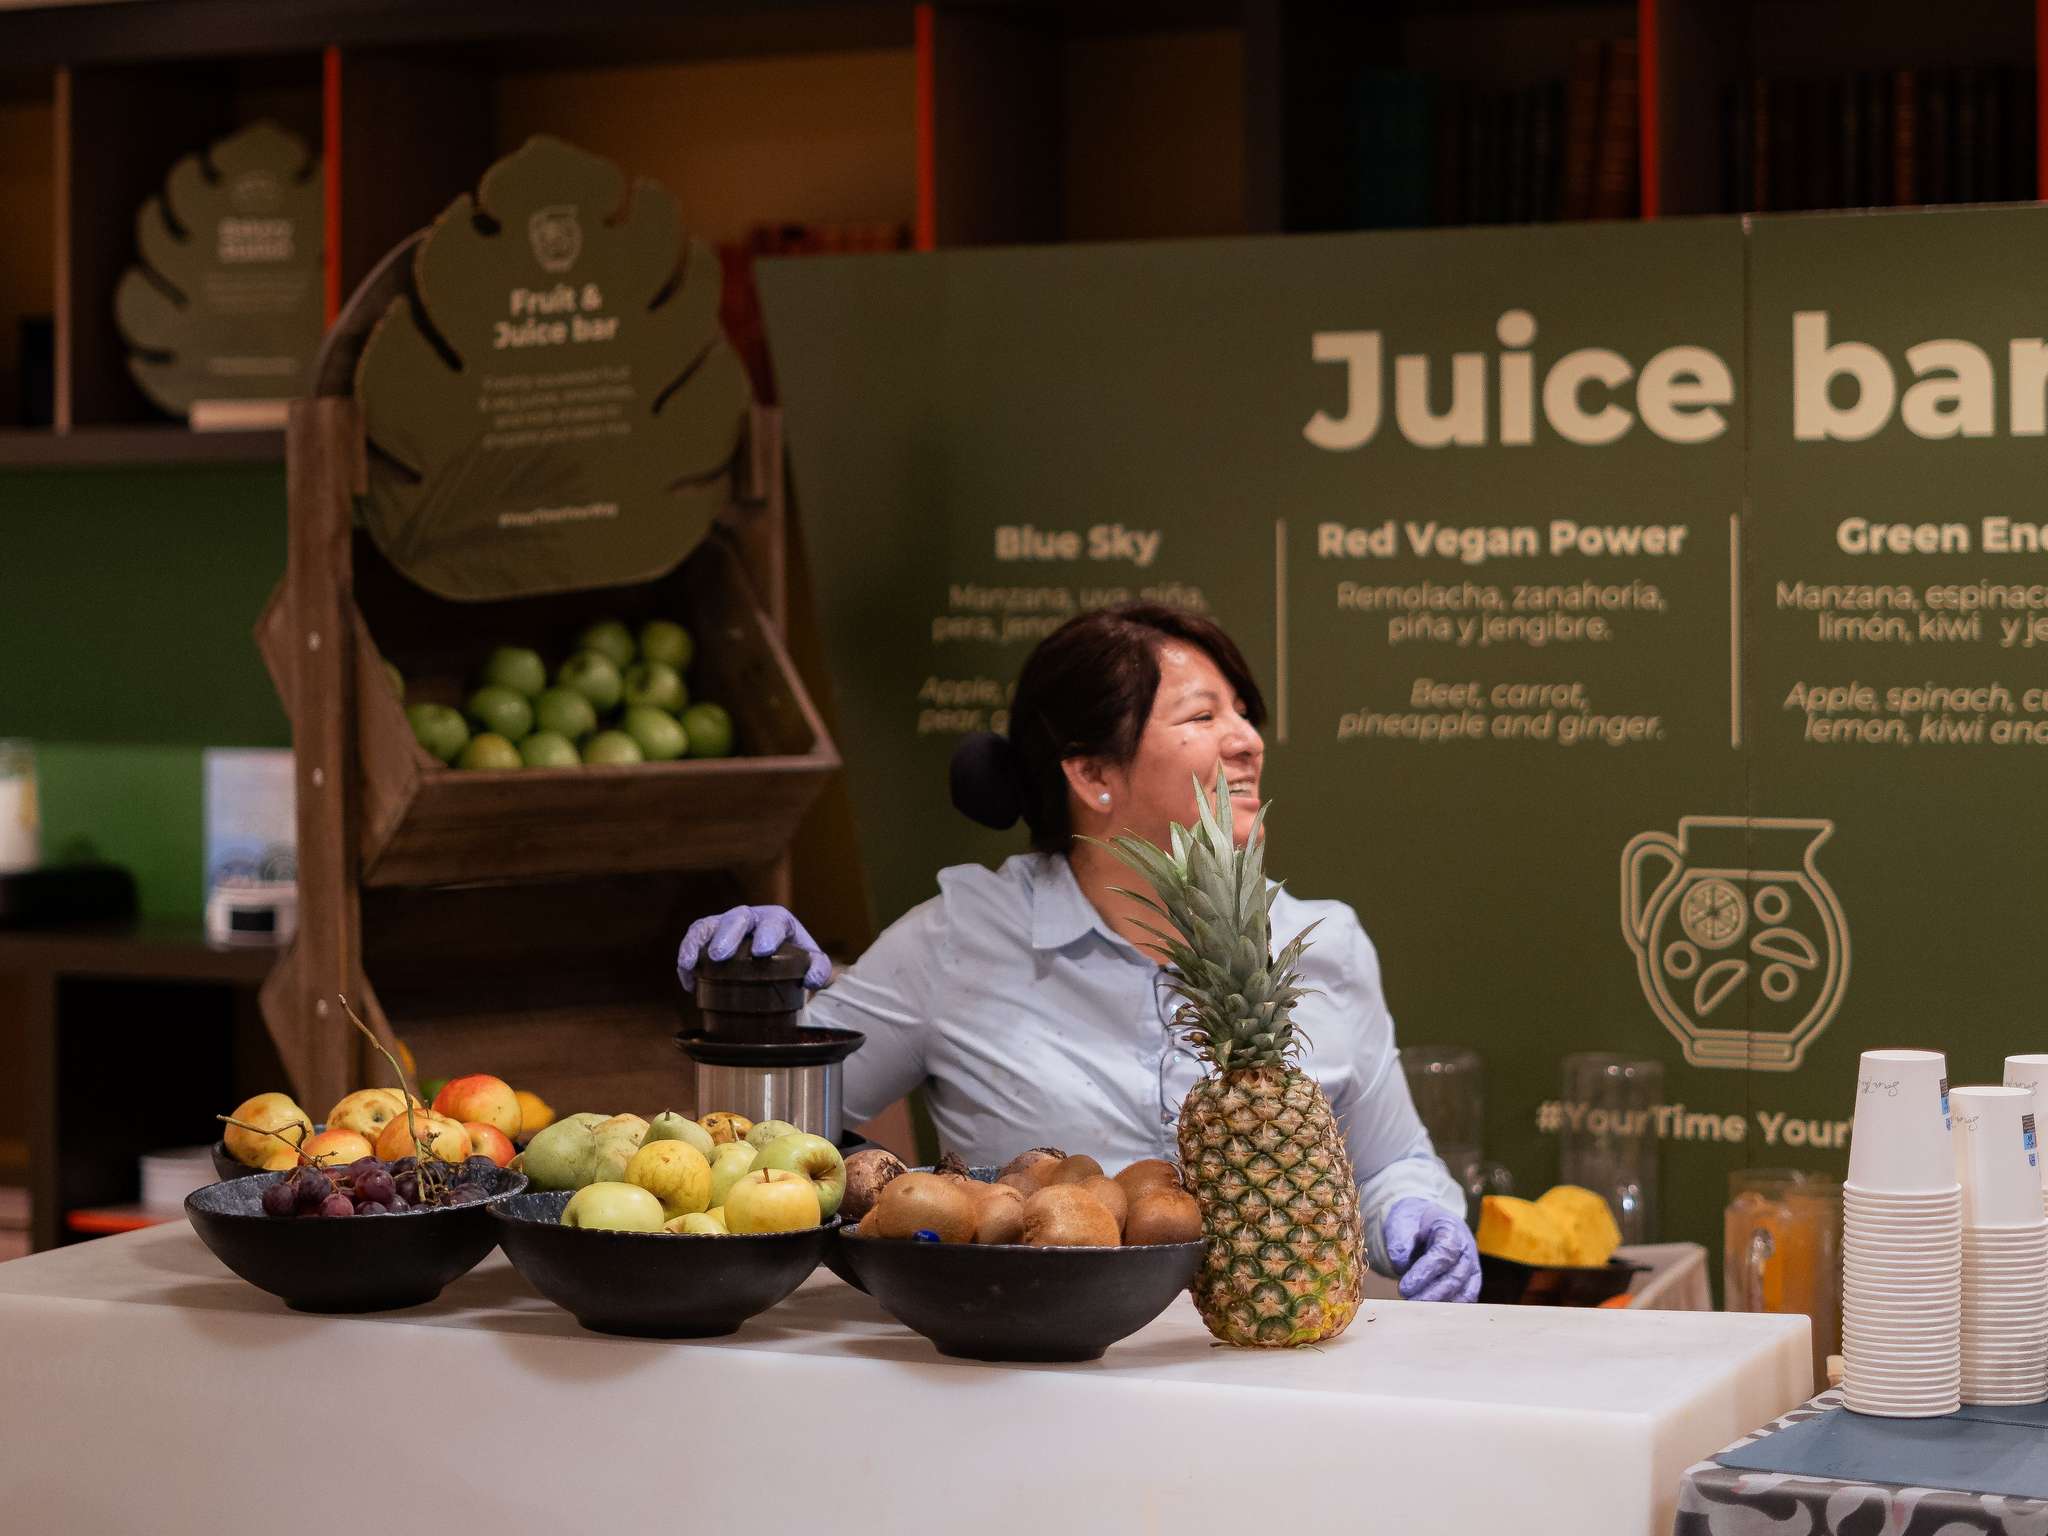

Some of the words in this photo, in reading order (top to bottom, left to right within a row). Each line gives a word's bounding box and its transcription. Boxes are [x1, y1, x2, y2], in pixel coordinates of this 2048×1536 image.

[494, 317, 566, 349] Juice
[572, 315, 619, 342] bar
[1303, 308, 1734, 450] Juice
[1793, 310, 2048, 441] bar
[995, 525, 1079, 560] Blue
[1087, 524, 1161, 567] Sky
[1318, 520, 1397, 557] Red
[1404, 521, 1539, 564] Vegan
[1550, 520, 1688, 556] Power
[1837, 517, 1969, 555] Green
[1337, 580, 1504, 611] Remolacha,
[1512, 579, 1667, 614] zanahoria,
[1776, 579, 1920, 612] Manzana,
[1925, 578, 2048, 614] espinac
[1389, 611, 1453, 645] piña
[1457, 615, 1477, 647] y
[1480, 611, 1613, 647] jengibre.
[1819, 610, 1912, 645] limón,
[1919, 610, 1983, 642] kiwi
[2000, 616, 2021, 648] y
[1410, 677, 1487, 710] Beet,
[1490, 680, 1590, 710] carrot,
[1783, 680, 1879, 717] Apple,
[1886, 680, 2015, 717] spinach,
[1337, 708, 1487, 743] pineapple
[1491, 709, 1556, 740] and
[1558, 709, 1666, 746] ginger.
[1805, 710, 1912, 746] lemon,
[1919, 713, 1987, 743] kiwi
[1537, 1100, 1747, 1142] #YourTime
[1756, 1110, 1853, 1148] Your
